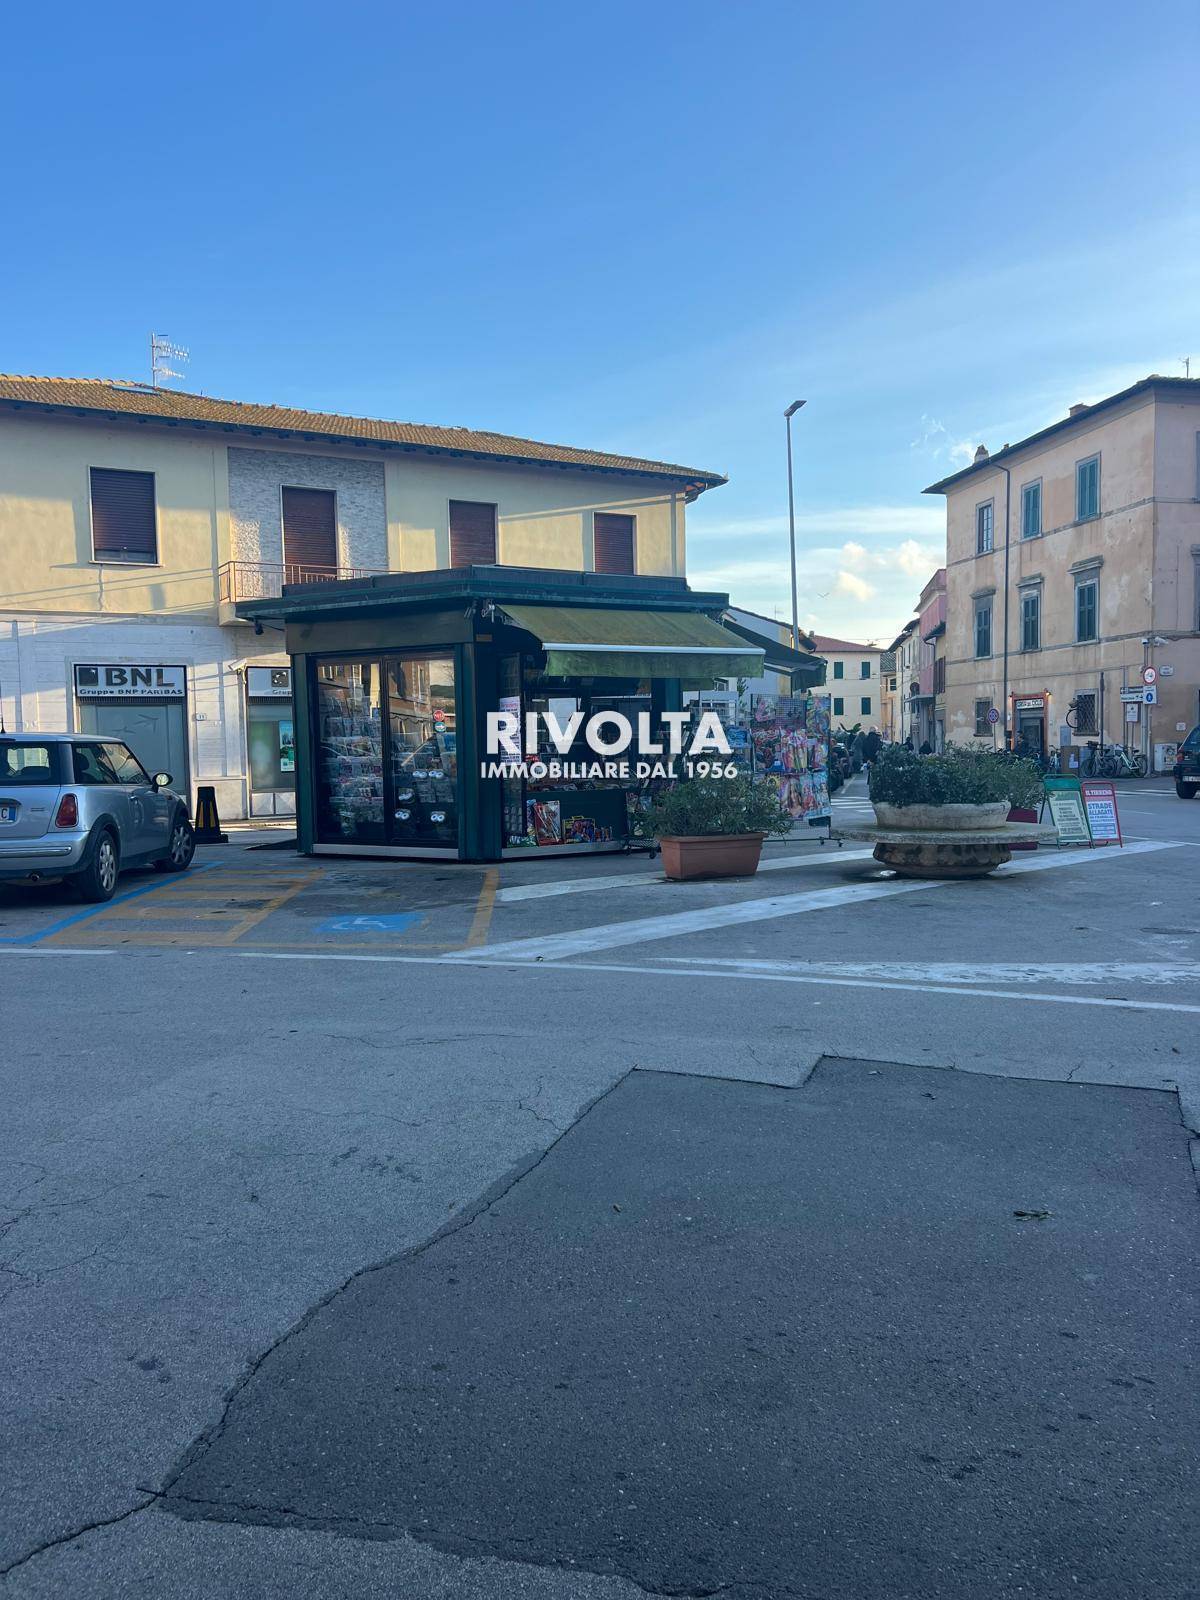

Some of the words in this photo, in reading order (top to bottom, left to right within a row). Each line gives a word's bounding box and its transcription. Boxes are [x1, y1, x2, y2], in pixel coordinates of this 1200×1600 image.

[105, 667, 175, 687] BNL
[79, 688, 115, 696] Gruppo
[1088, 802, 1113, 810] STRADE
